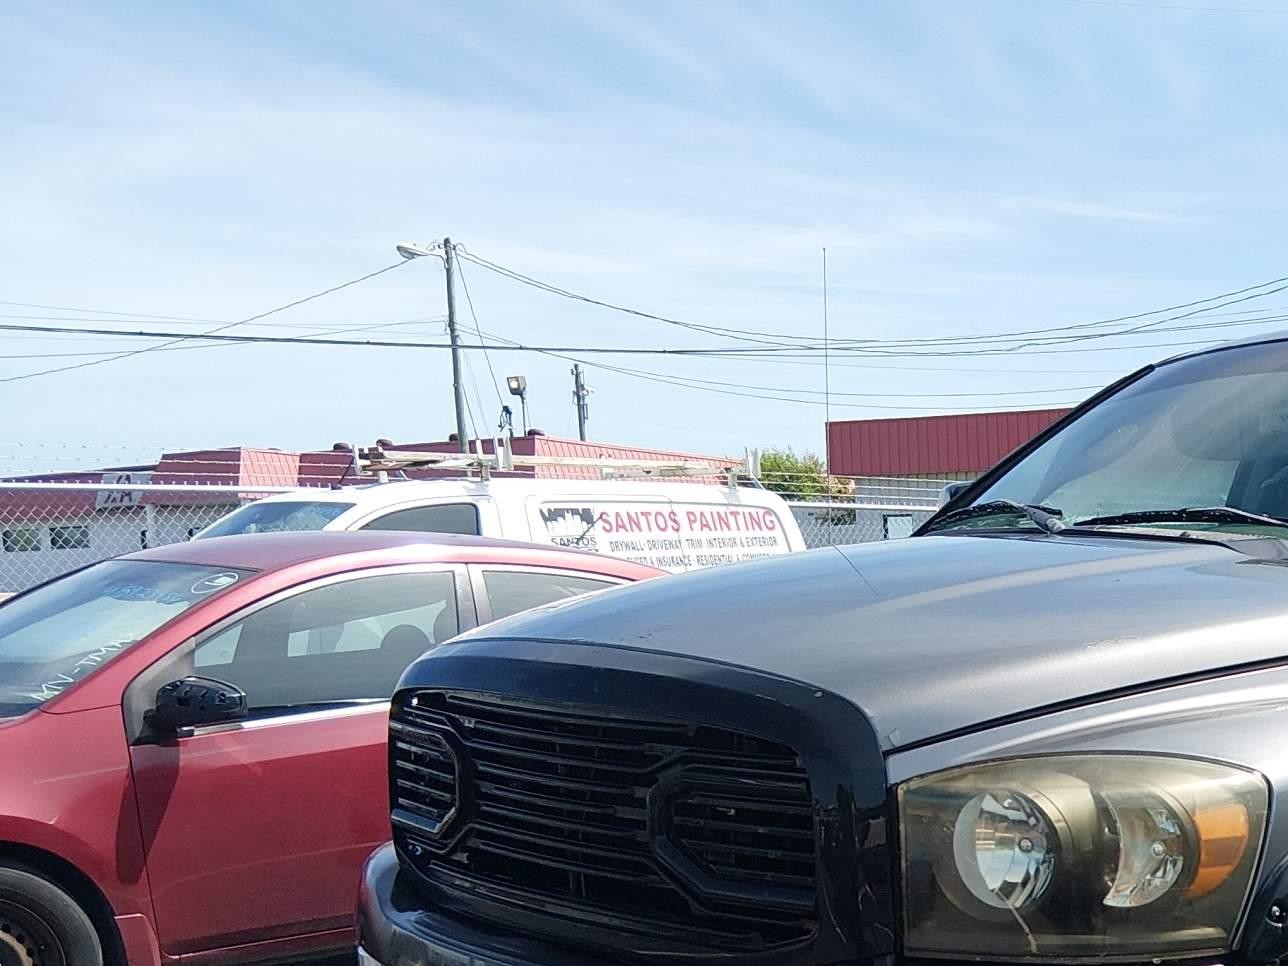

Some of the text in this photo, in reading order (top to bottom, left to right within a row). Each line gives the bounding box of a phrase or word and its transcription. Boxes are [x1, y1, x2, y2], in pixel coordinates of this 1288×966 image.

[599, 510, 776, 533] SANTOS PAINTING
[647, 539, 681, 551] DRIVEWAY
[685, 538, 703, 549] TRIM
[706, 537, 737, 549] INTERIOR
[745, 536, 777, 547] EXTERIOR
